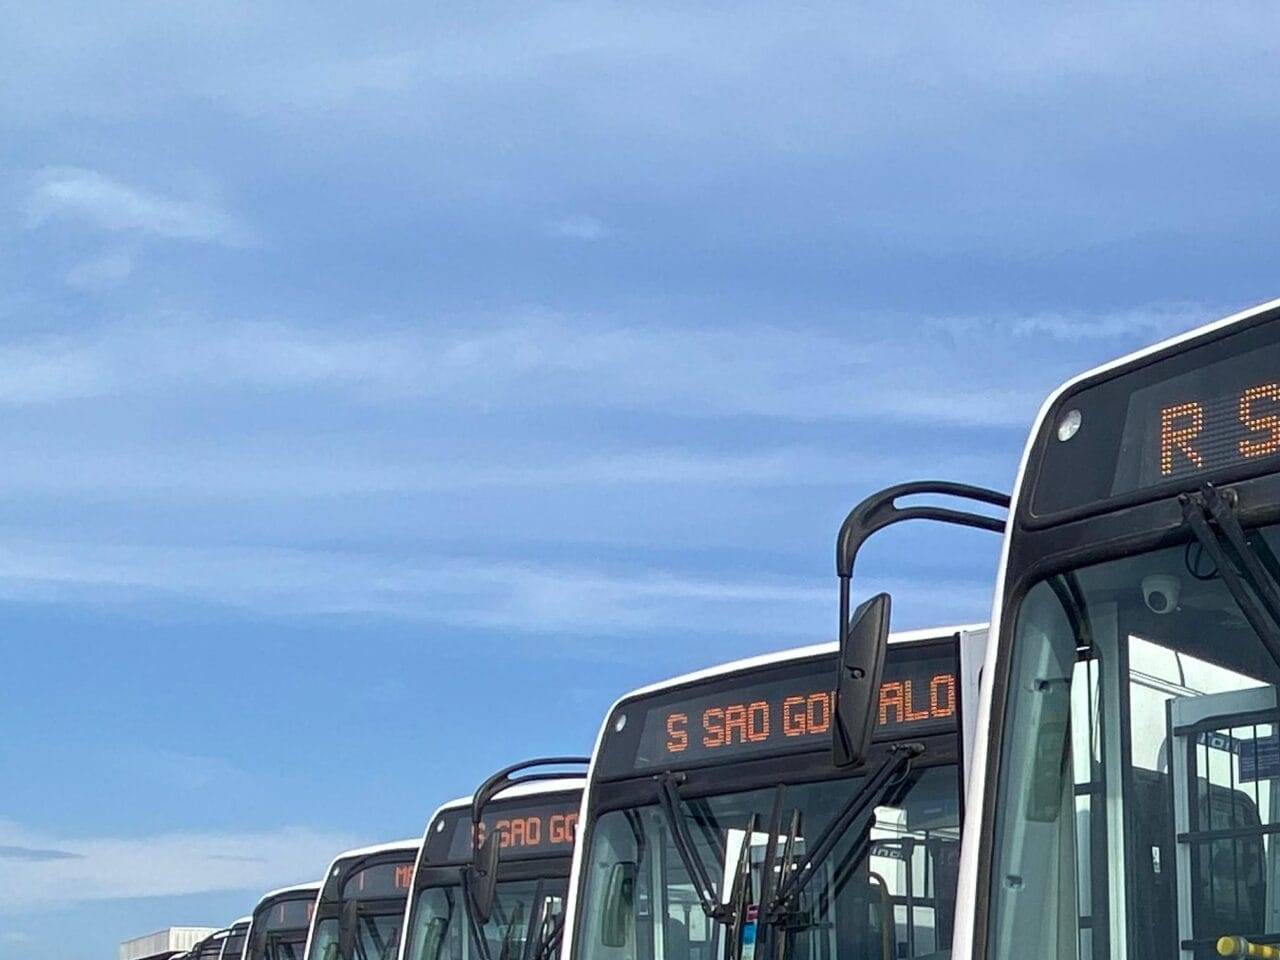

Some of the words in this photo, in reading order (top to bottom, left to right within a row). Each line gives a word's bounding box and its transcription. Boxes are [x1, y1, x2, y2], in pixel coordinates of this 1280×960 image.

[1160, 402, 1203, 476] R
[666, 713, 688, 753] S
[702, 700, 770, 748] SAO
[783, 673, 955, 737] GOALO
